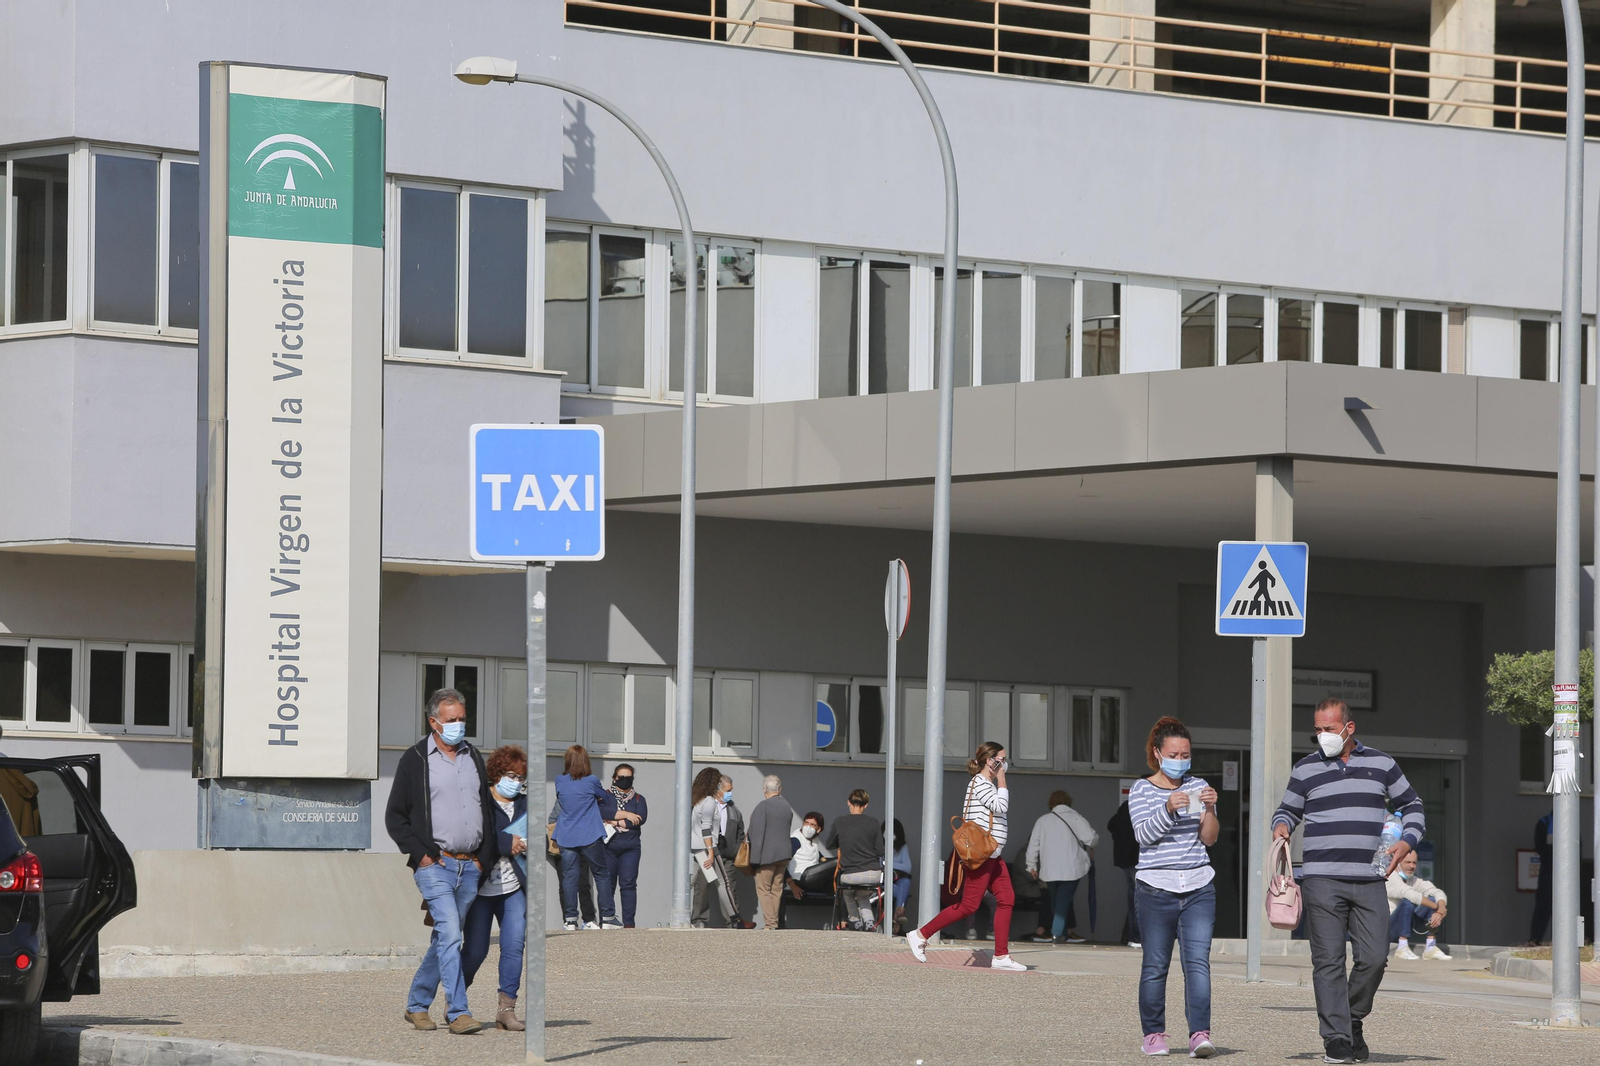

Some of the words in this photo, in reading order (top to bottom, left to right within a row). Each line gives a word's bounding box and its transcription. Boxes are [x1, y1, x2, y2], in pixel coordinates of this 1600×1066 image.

[244, 190, 272, 204] JUNTA
[276, 193, 287, 206] DE
[290, 194, 338, 210] ANDALUCIA
[272, 259, 305, 382] Victoria
[271, 397, 303, 424] la
[271, 440, 303, 479] de
[481, 473, 595, 511] TAXI
[269, 494, 310, 597] Virgen
[268, 612, 308, 746] Hospital
[1292, 676, 1318, 686] Consultas
[1319, 678, 1342, 687] Externas
[1343, 679, 1357, 688] Patio
[1358, 680, 1370, 688] Azul
[282, 809, 324, 823] CONSEJERÍA
[325, 813, 335, 823] DE
[336, 812, 359, 823] SALUD
[296, 800, 314, 808] Servicio
[346, 800, 359, 808] Salud
